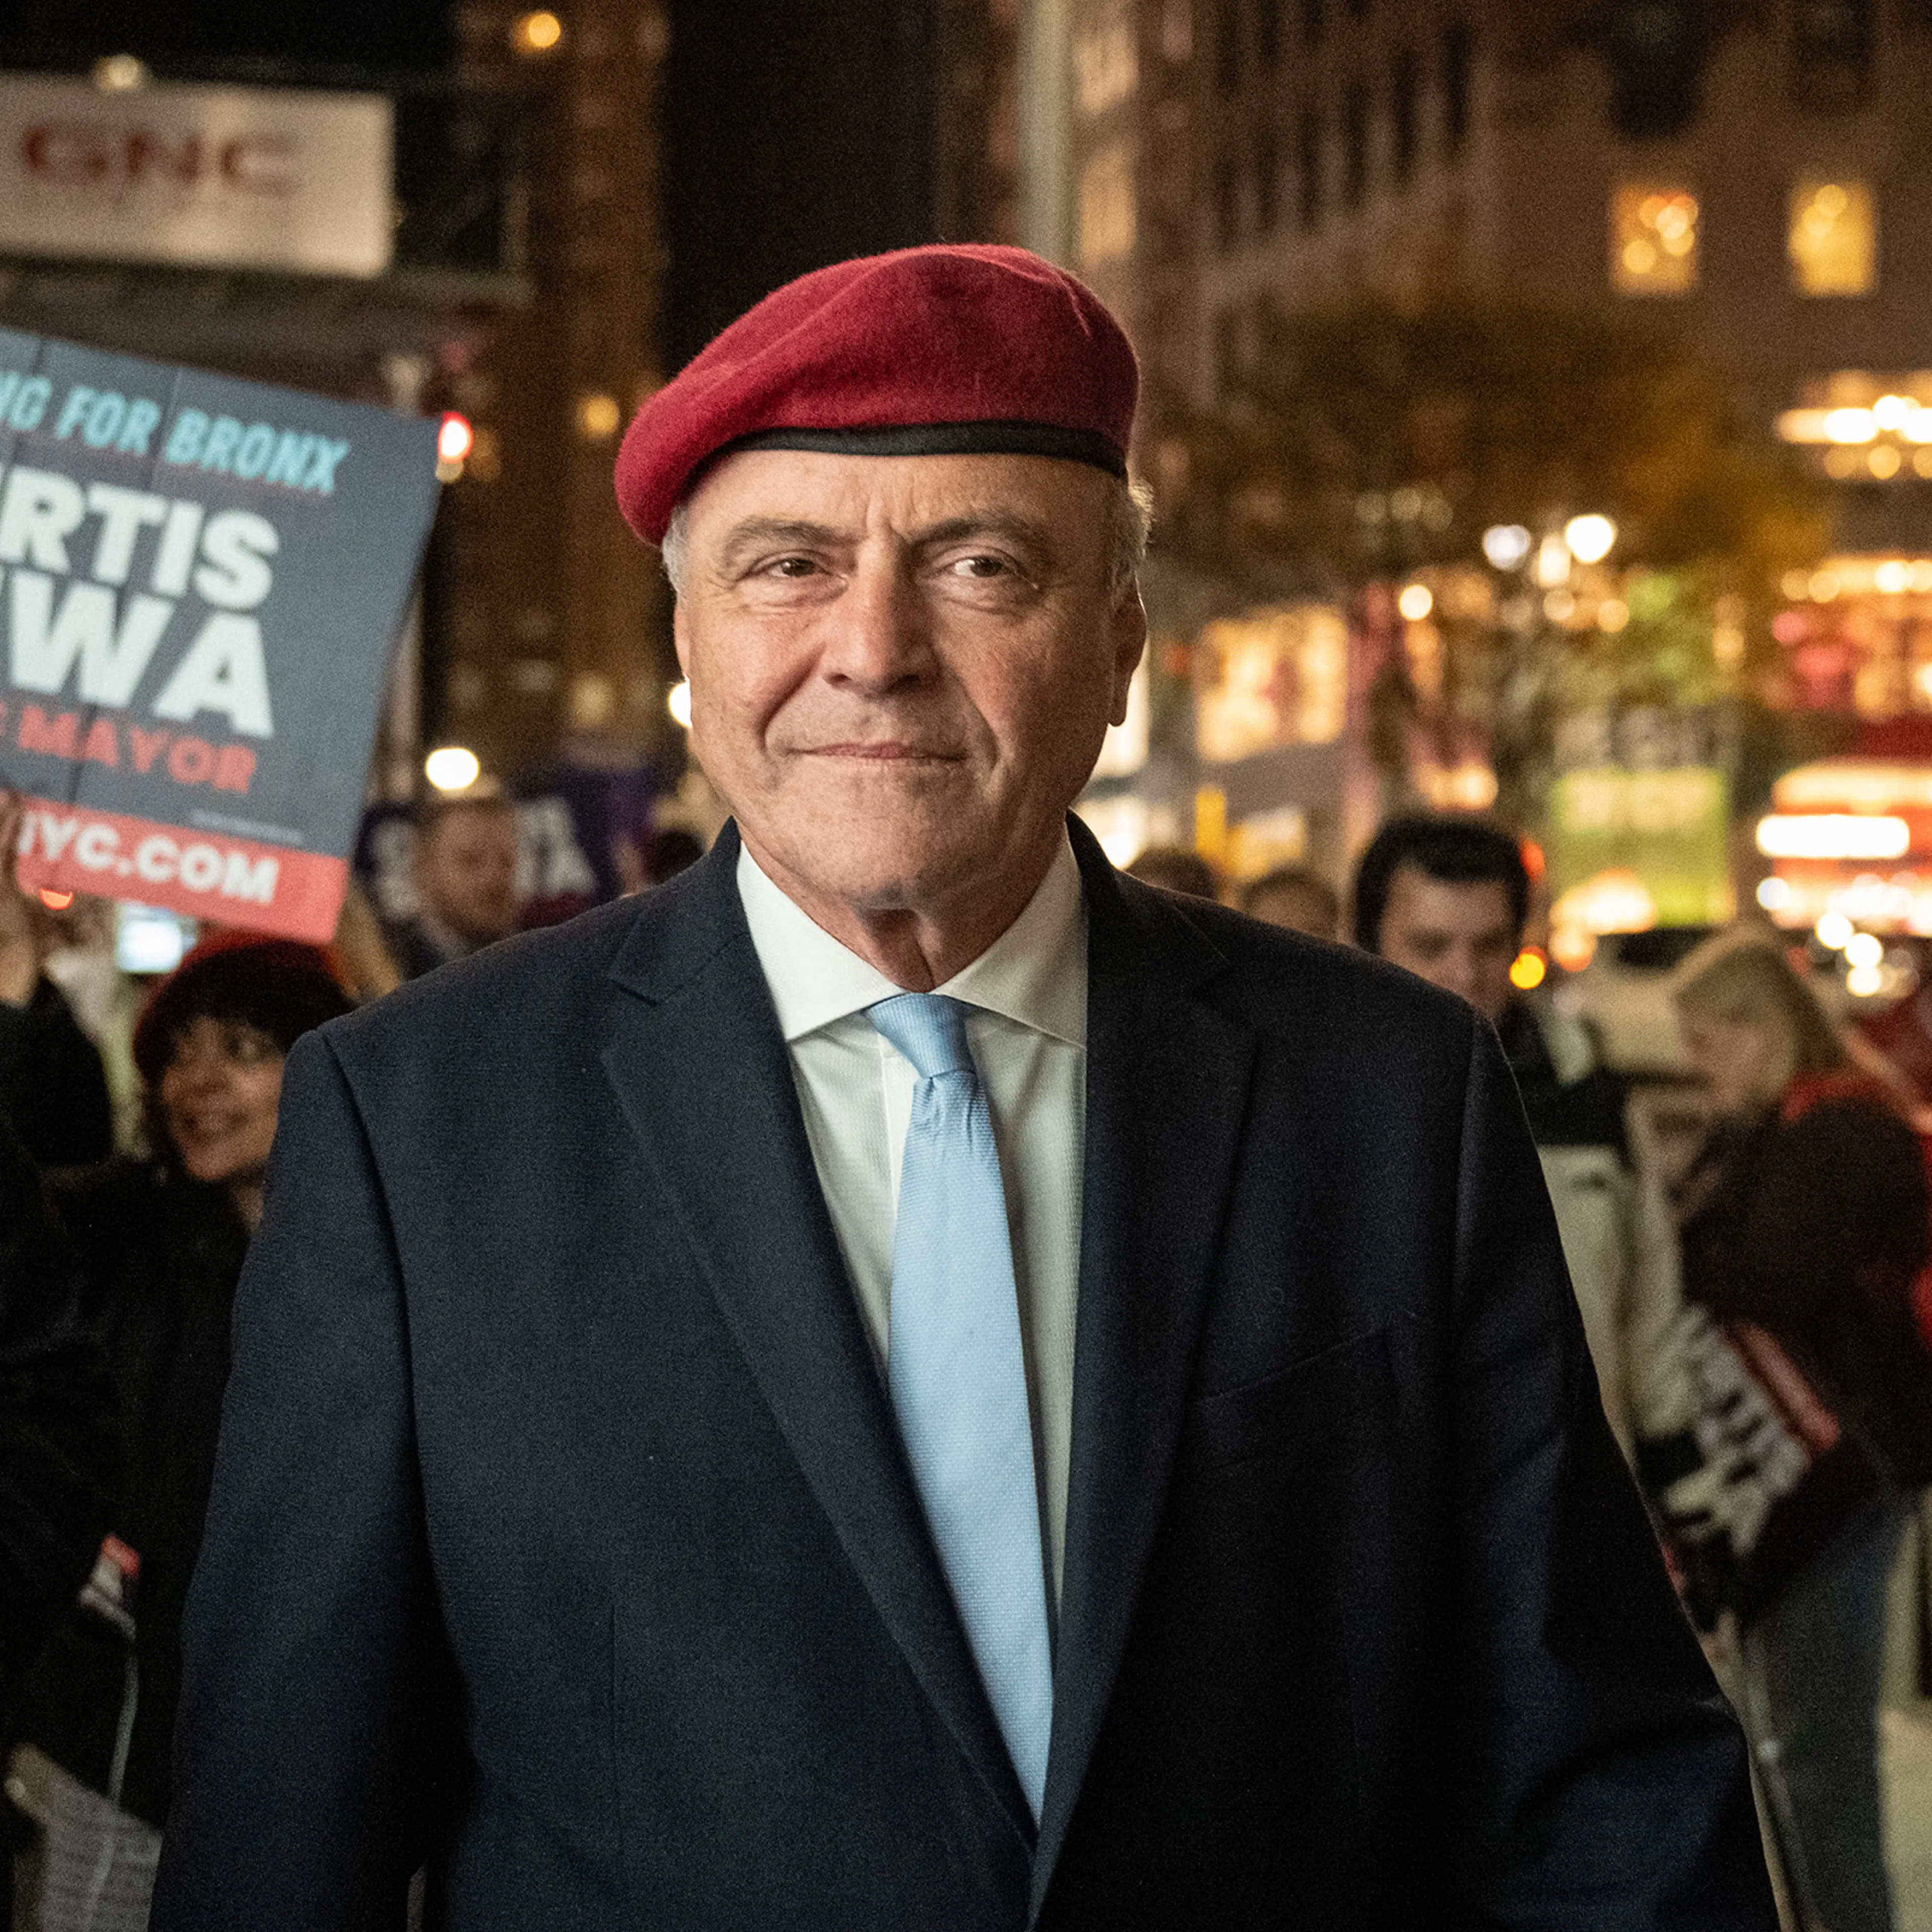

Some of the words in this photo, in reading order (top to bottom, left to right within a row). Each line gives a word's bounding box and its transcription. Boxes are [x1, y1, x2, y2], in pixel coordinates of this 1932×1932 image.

[20, 124, 301, 196] GNC
[56, 386, 161, 455] FOR
[165, 408, 351, 495] BRONX
[0, 464, 280, 610] RTIS
[0, 569, 274, 740] WA
[18, 705, 257, 794] MAYOR
